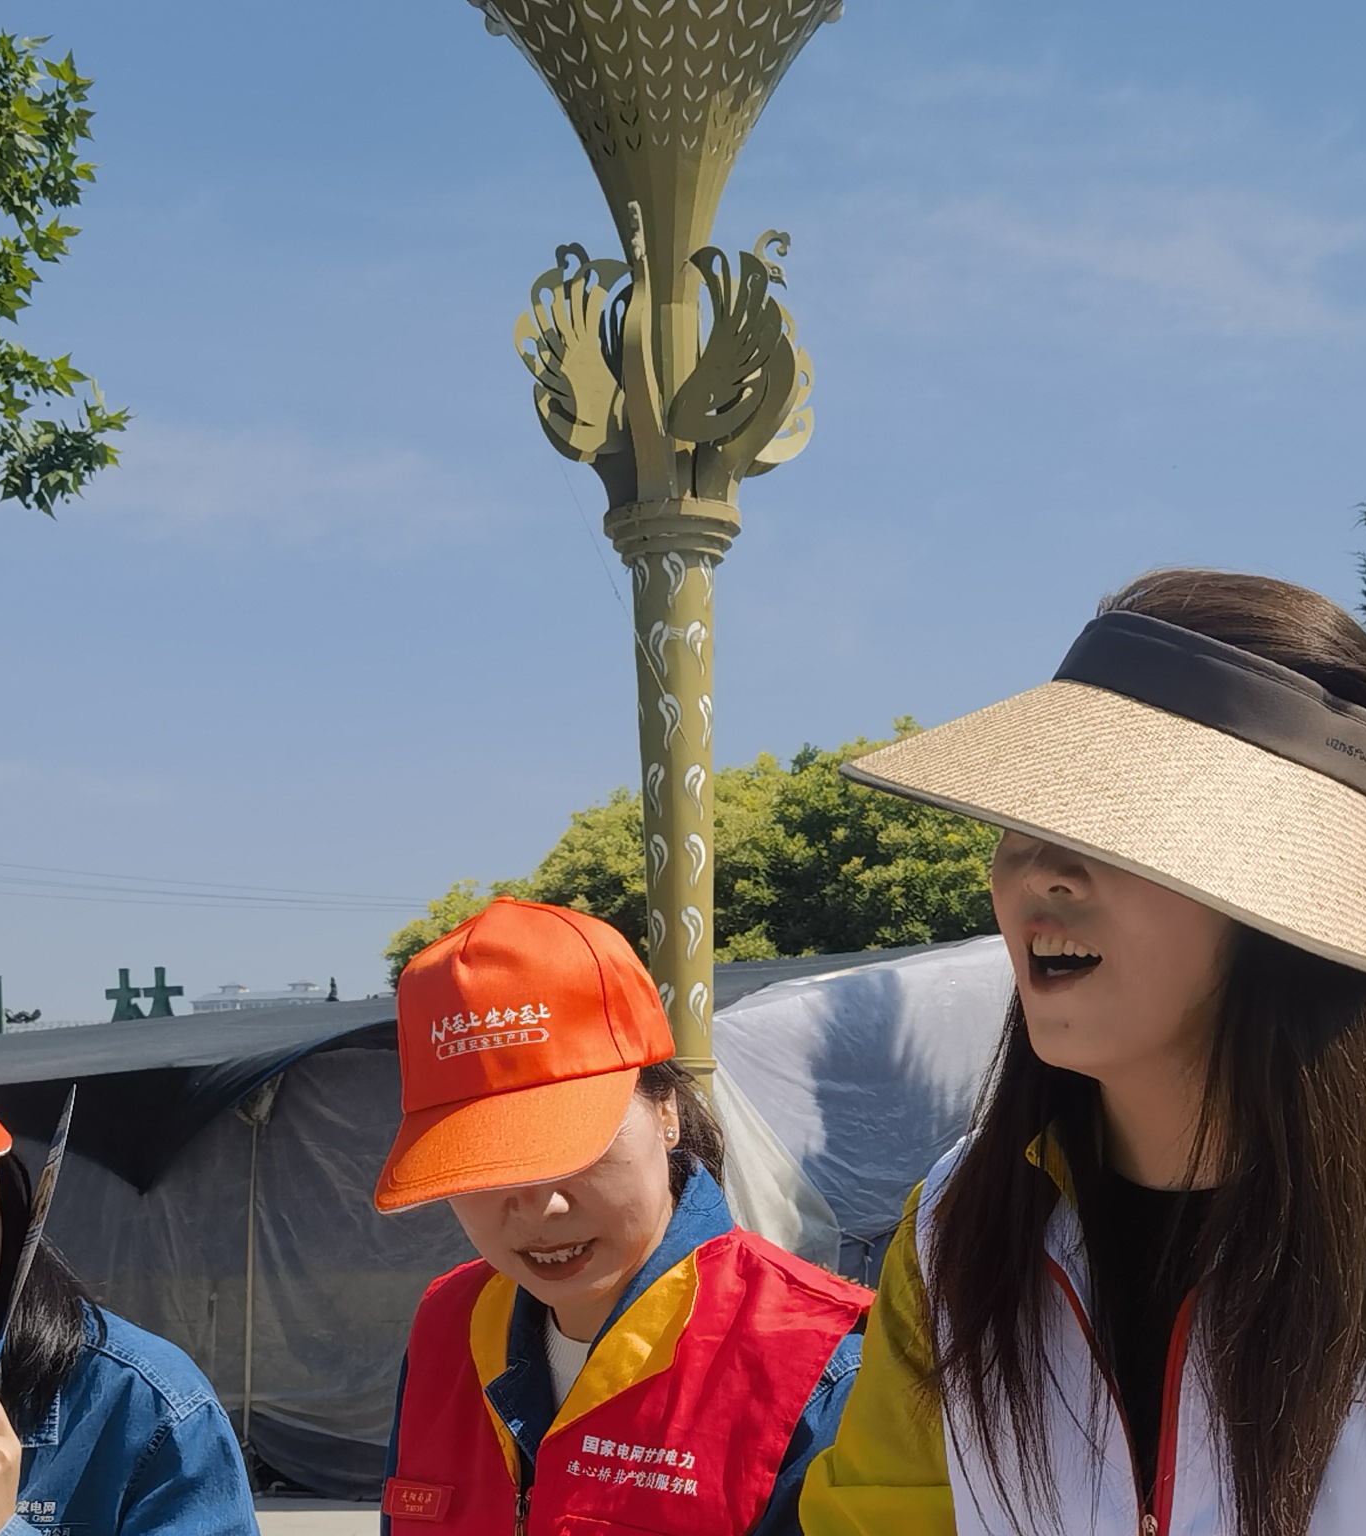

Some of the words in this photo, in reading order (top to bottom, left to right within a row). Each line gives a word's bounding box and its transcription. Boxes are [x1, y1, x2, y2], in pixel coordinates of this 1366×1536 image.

[484, 1002, 552, 1029] 生命至上
[582, 1435, 696, 1469] 国家电网甘肃电力
